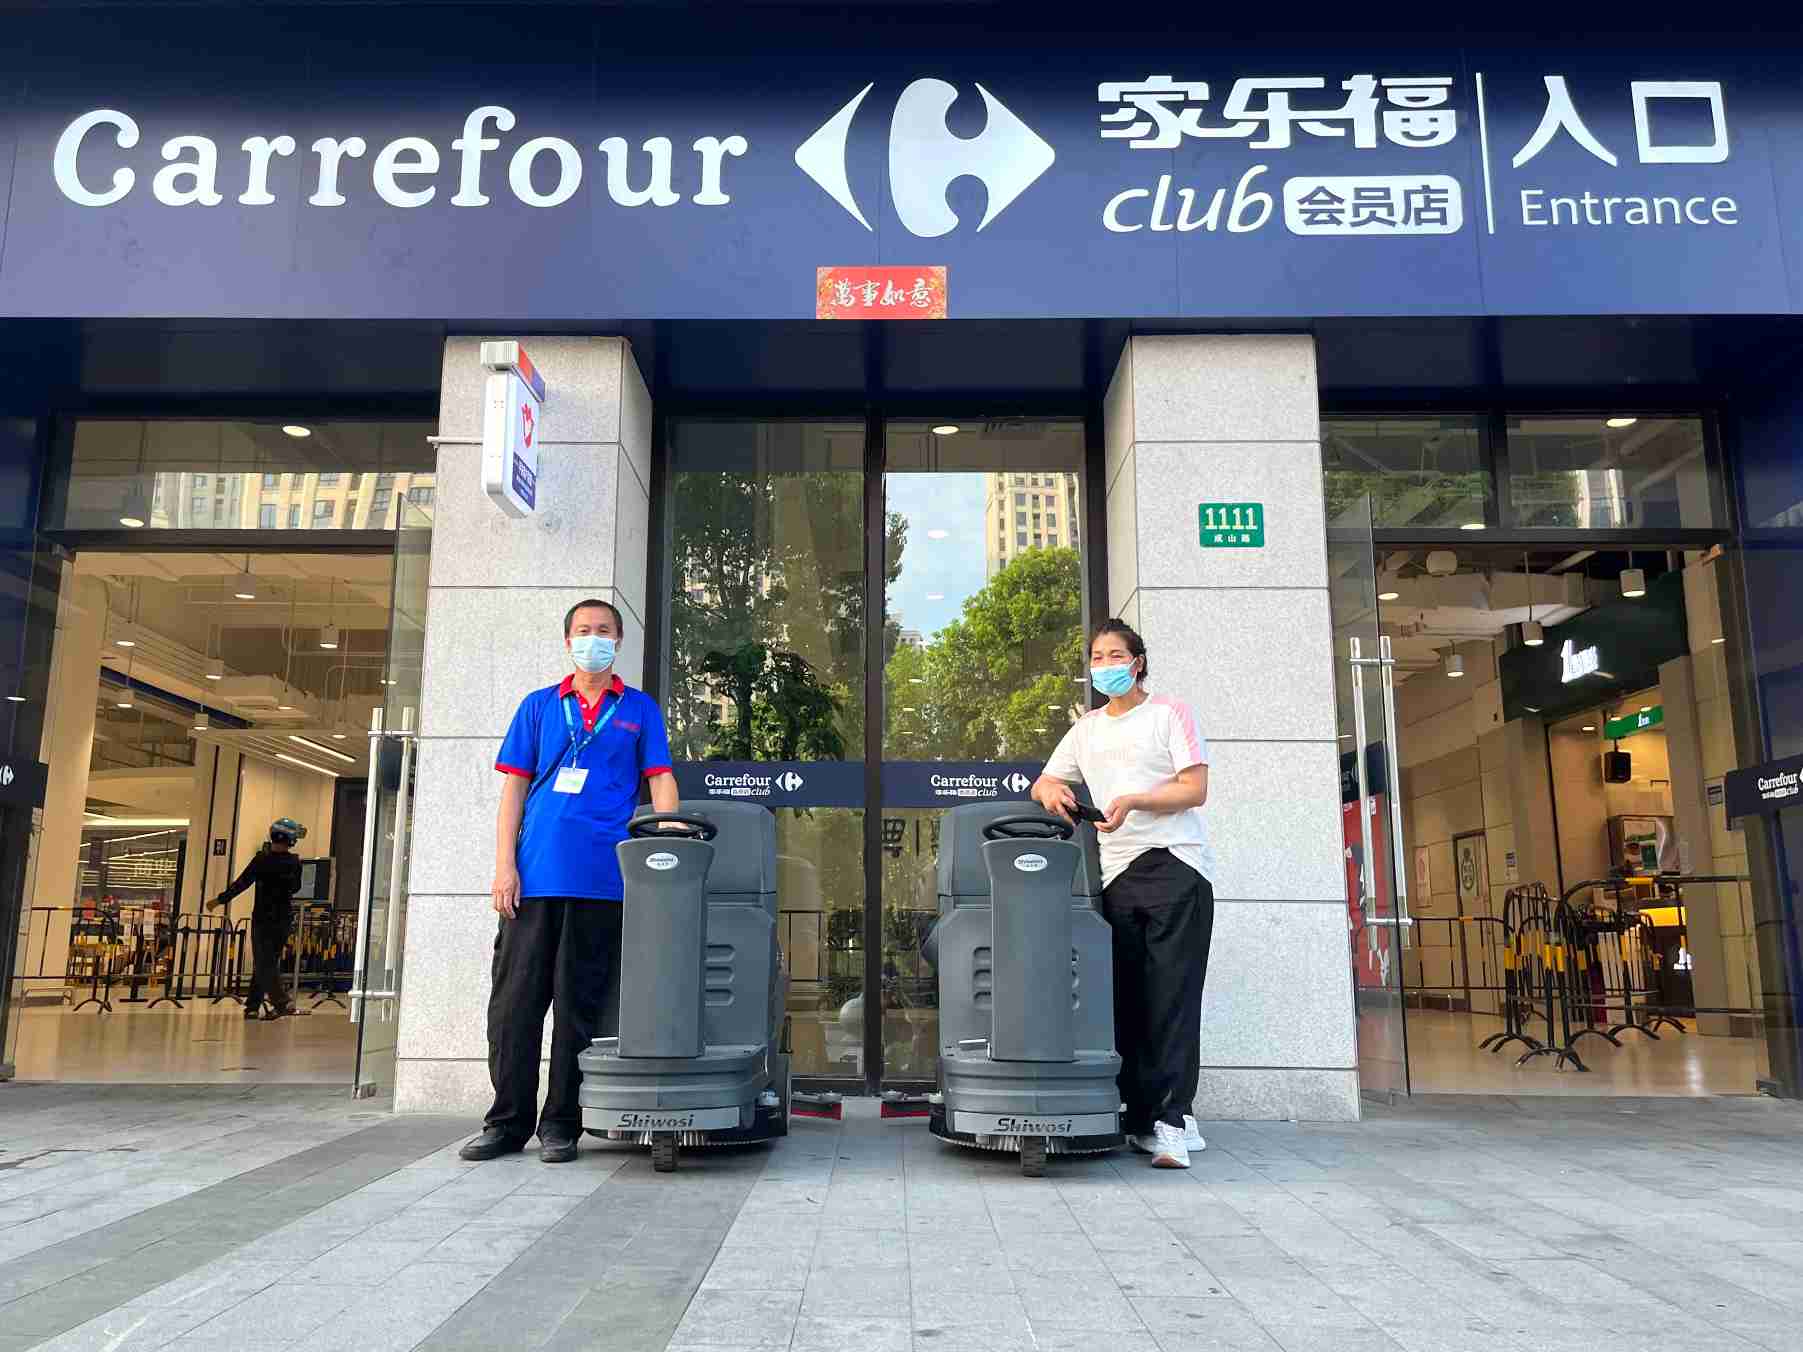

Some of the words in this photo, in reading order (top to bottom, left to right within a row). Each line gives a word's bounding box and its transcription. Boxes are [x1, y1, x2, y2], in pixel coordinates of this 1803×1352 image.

[1098, 74, 1457, 150] 家乐福
[1512, 75, 1729, 169] 入口
[53, 105, 748, 208] Carrefour
[1102, 164, 1275, 233] club
[1296, 184, 1450, 227] 会员店
[1520, 189, 1738, 226] Entrance
[831, 277, 931, 308] 萬事如意
[1205, 507, 1258, 530] 1111
[704, 773, 771, 786] Carrefour
[930, 774, 998, 787] Carrefour
[977, 787, 998, 797] club
[1758, 772, 1798, 791] Carrefour
[617, 1113, 695, 1128] Shiwosi
[993, 1117, 1073, 1133] Shiwosi
